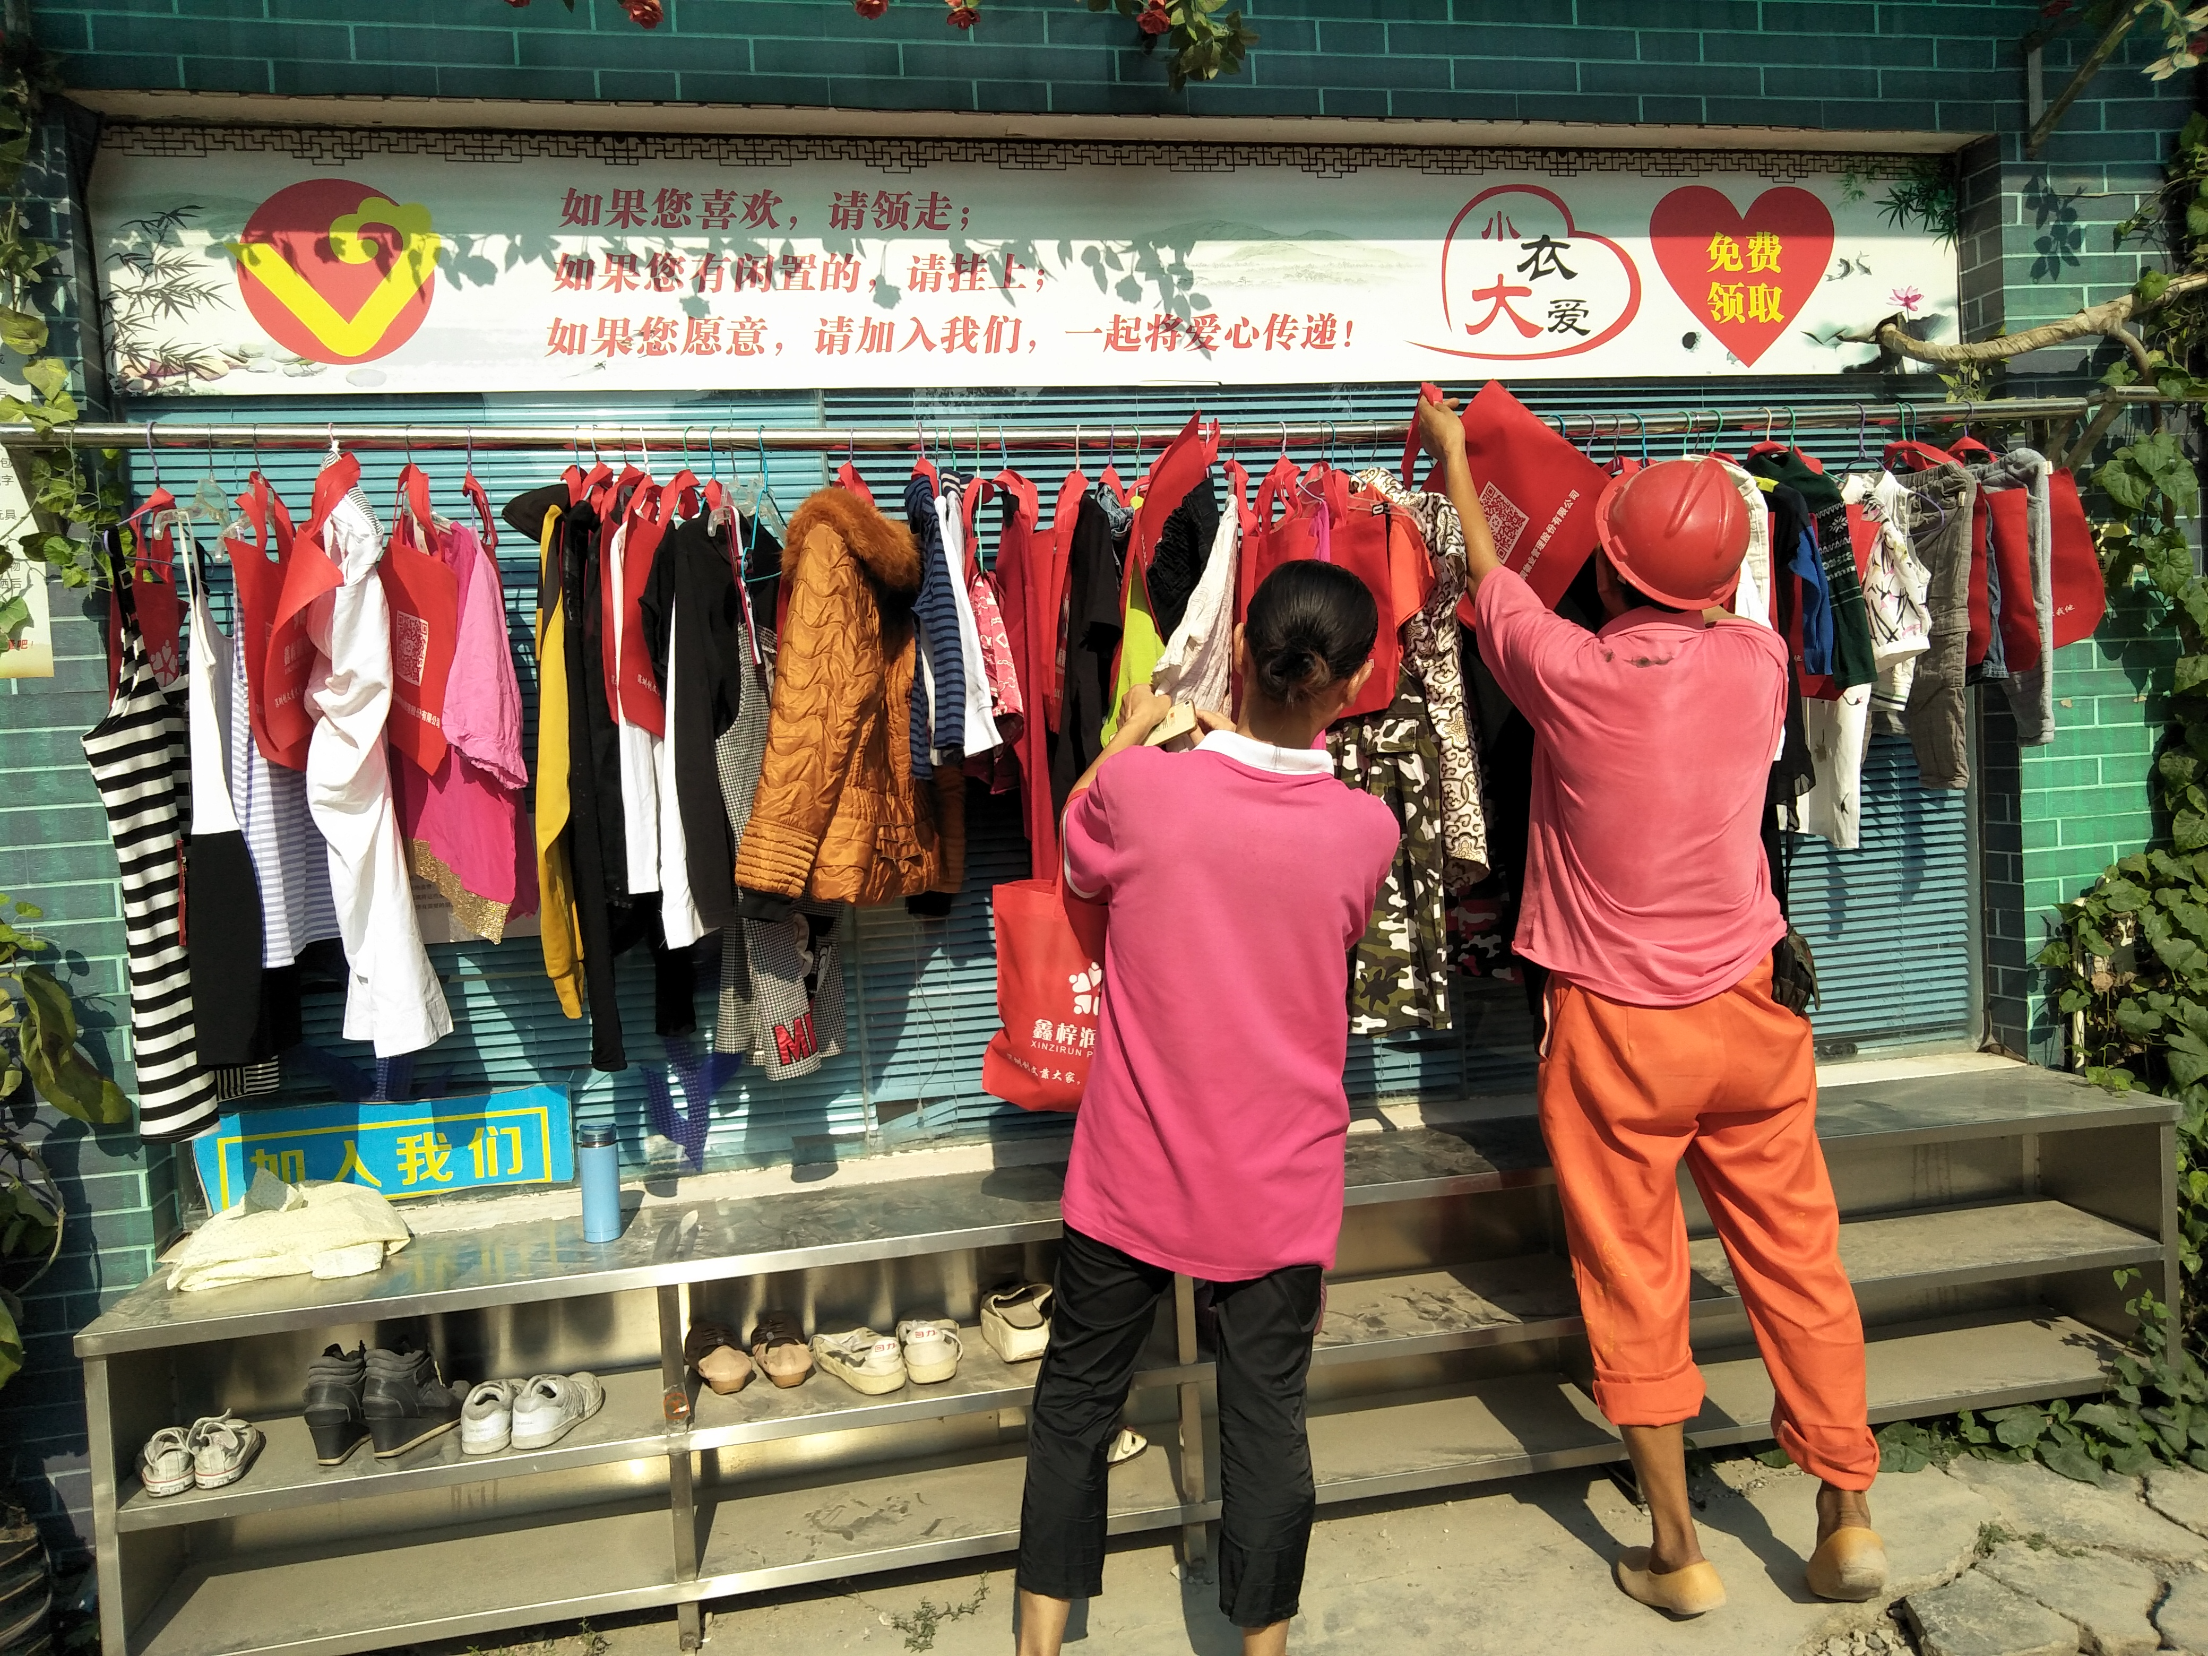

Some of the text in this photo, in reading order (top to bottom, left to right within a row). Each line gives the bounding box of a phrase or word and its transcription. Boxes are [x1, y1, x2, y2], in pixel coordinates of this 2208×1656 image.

[558, 187, 972, 232] 如果您喜欢，请领走；
[551, 252, 1046, 293] 如果您有闲置的，请挂上；
[1706, 231, 1783, 275] 免费
[1706, 281, 1786, 325] 领取
[1030, 1039, 1082, 1057] XINZIRUN
